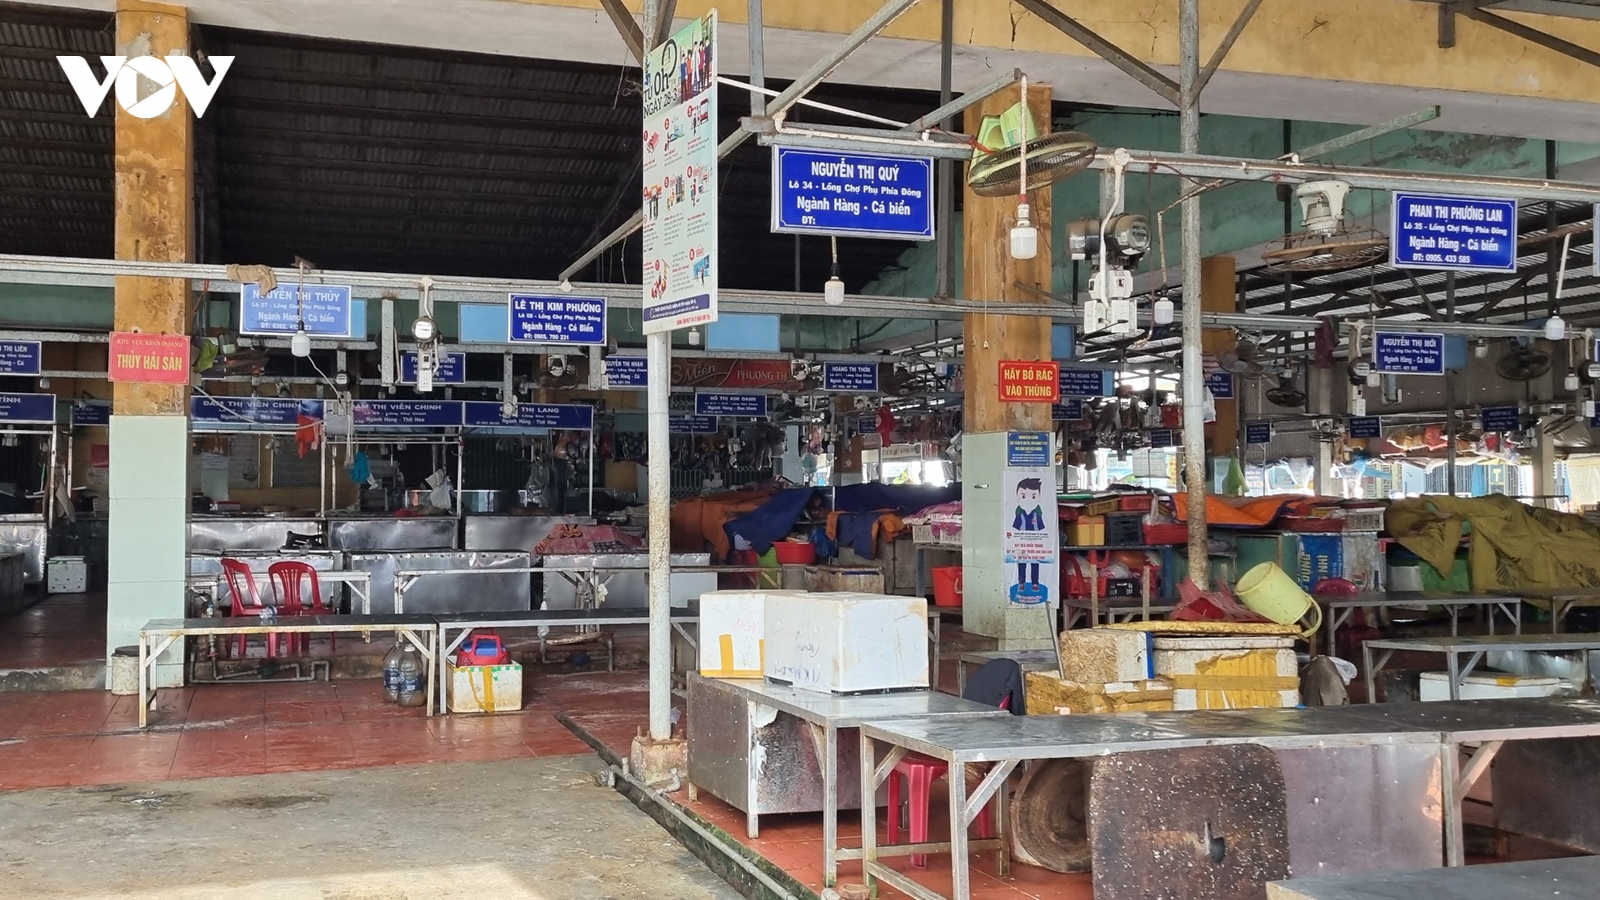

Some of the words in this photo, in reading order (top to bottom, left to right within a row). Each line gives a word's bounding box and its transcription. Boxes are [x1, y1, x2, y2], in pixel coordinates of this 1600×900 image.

[644, 96, 662, 119] NGÀY
[664, 88, 677, 107] 28-3
[811, 158, 854, 179] NGUYỄN
[858, 165, 875, 184] THỊ
[878, 164, 899, 181] QUÝ
[789, 180, 799, 189] Lô
[802, 181, 813, 189] 34
[845, 184, 860, 195] Chợ
[863, 186, 878, 195] Phụ
[881, 187, 898, 195] Phía
[901, 188, 921, 198] Đông
[797, 196, 830, 212] Ngành
[834, 197, 860, 215] Hàng
[871, 200, 885, 215] Cá
[889, 200, 910, 215] biển
[1410, 204, 1432, 218] PHAN
[1435, 206, 1448, 222] THỊ
[1486, 209, 1502, 222] LAN
[1447, 224, 1459, 234] Chợ
[1461, 226, 1473, 234] Phụ
[1491, 227, 1507, 236] Đông
[1409, 236, 1435, 250] Ngành
[1438, 237, 1459, 252] Hàng
[1467, 239, 1478, 251] Cá
[252, 288, 292, 300] NUYỄN
[515, 299, 526, 309] LÊ
[529, 302, 544, 313] THỊ
[547, 302, 563, 311] KIM
[566, 302, 601, 313] PHƯƠNG
[258, 312, 280, 322] Ngành
[522, 322, 542, 332] Ngành
[545, 322, 561, 332] Hàng
[568, 323, 577, 332] Cá
[117, 350, 141, 368] THỦY
[143, 351, 159, 370] HẢI
[162, 352, 182, 371] SẢN
[1004, 368, 1020, 380] HÃY
[1022, 366, 1034, 380] BỎ
[1036, 367, 1053, 380] RÁC
[1006, 384, 1022, 396] VÀO
[1024, 383, 1051, 397] THÙNG
